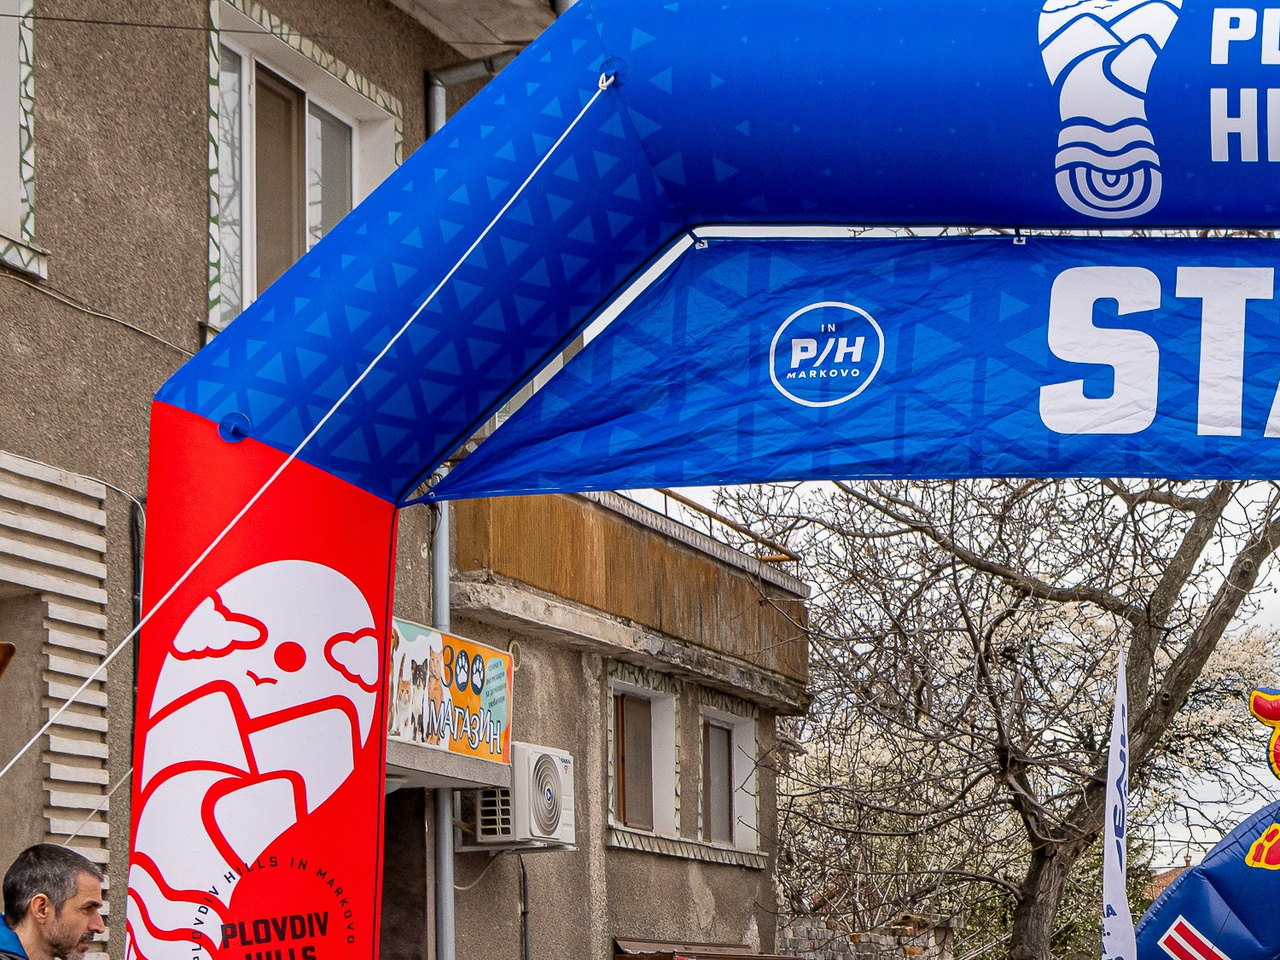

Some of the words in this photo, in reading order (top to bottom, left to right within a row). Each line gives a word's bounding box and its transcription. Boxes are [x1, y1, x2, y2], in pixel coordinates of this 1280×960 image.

[820, 324, 836, 333] IN
[790, 336, 864, 370] P/H
[786, 368, 861, 380] MARKOVO
[428, 698, 502, 754] МАГАЗИН
[223, 856, 278, 884] HILLS
[290, 857, 308, 870] IN
[315, 868, 355, 944] MARKOVO
[220, 911, 330, 949] PLOVDIV
